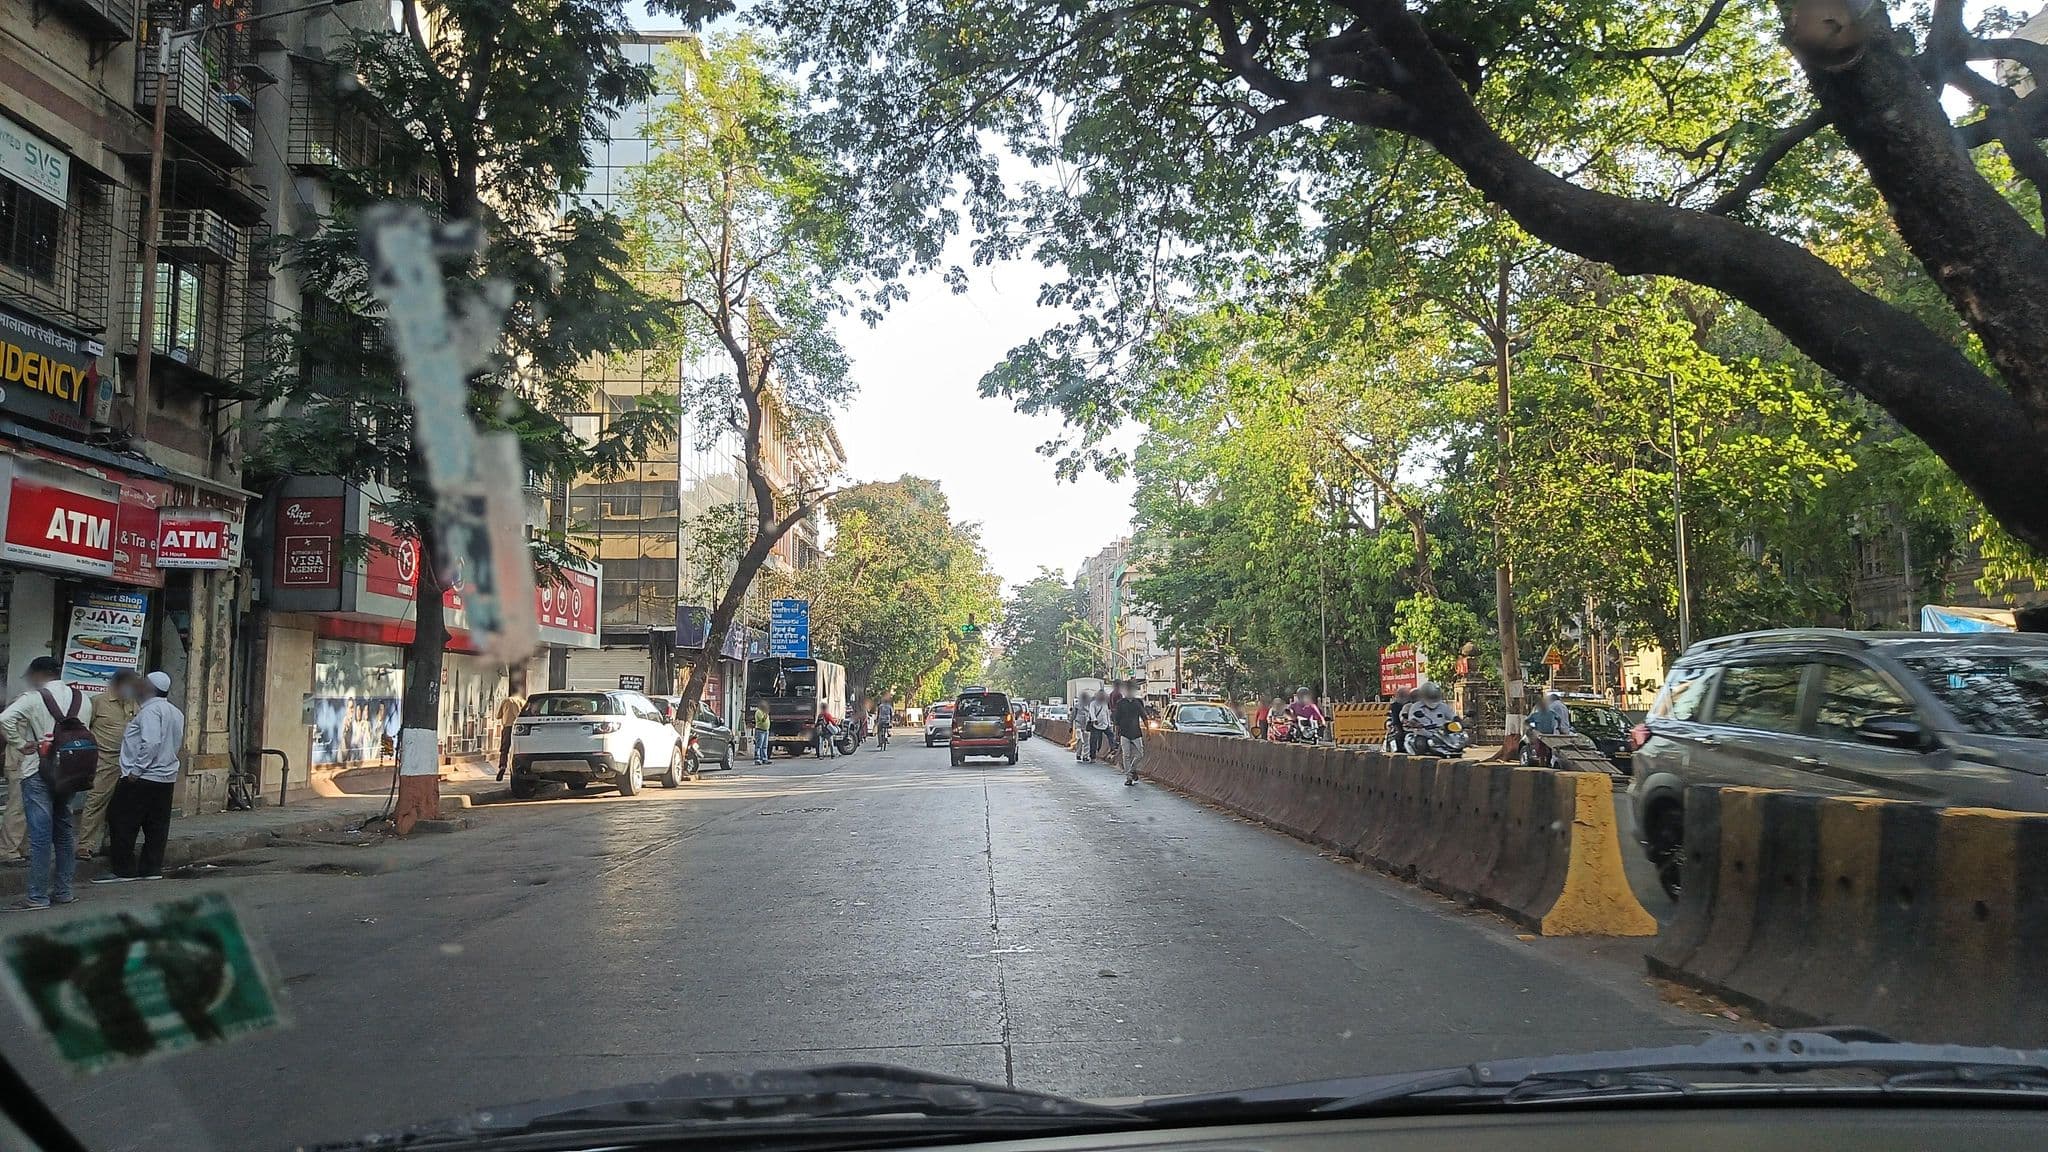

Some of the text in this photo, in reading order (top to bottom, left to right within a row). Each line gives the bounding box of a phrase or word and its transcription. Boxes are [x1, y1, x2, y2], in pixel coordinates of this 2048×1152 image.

[25, 142, 62, 179] SVS
[45, 507, 111, 550] ATM
[120, 530, 156, 550] & Trae
[162, 531, 217, 549] ATM
[221, 524, 229, 559] ATM
[290, 556, 324, 566] VISA
[289, 566, 324, 574] AGENTS
[118, 594, 143, 605] Shop
[86, 610, 129, 625] JAYA
[95, 655, 137, 664] BOOKING
